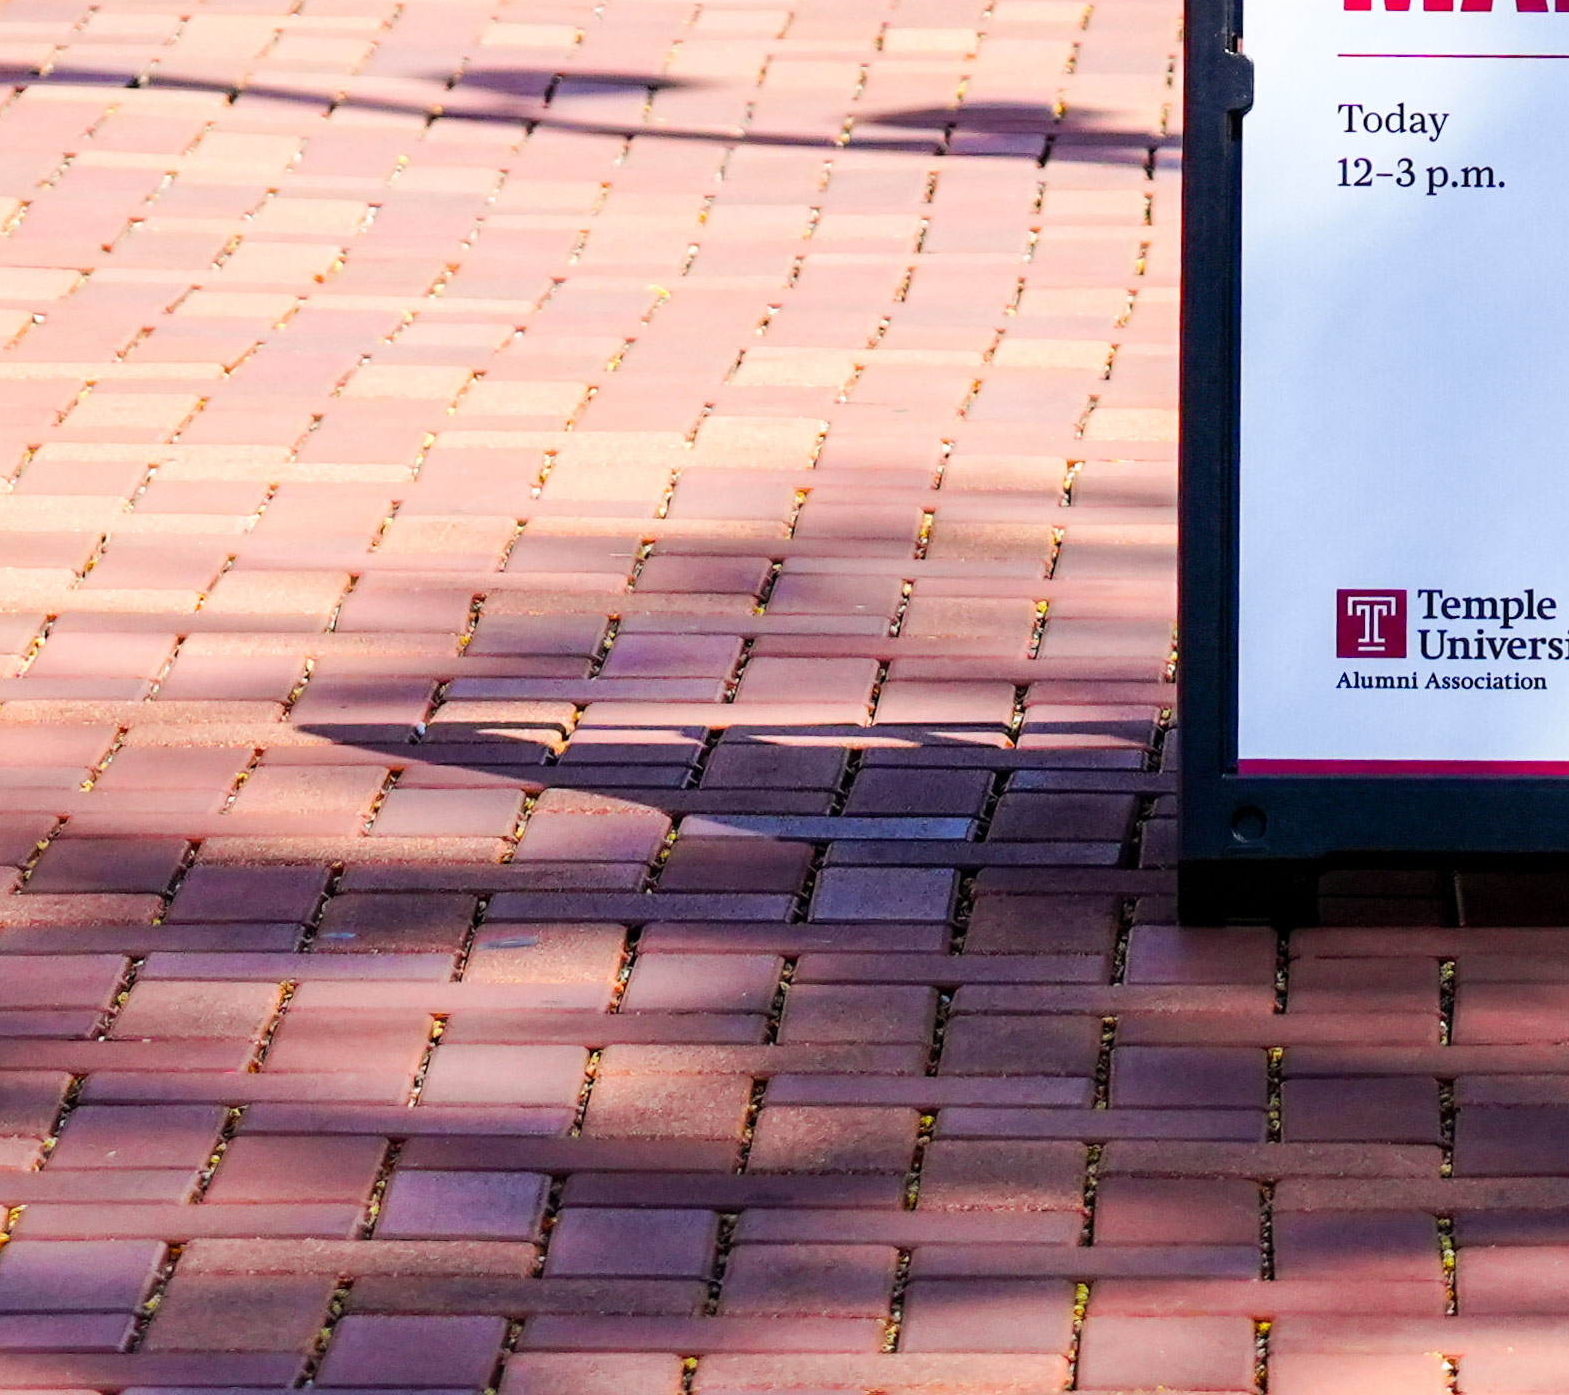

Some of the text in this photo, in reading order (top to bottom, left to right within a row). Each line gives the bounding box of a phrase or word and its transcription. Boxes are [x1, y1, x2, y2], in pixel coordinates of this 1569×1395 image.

[1337, 103, 1450, 142] Today
[1426, 166, 1507, 197] p.m.
[1347, 596, 1398, 652] T
[1417, 588, 1557, 629] Temple
[1336, 671, 1548, 691] Alumni Association
